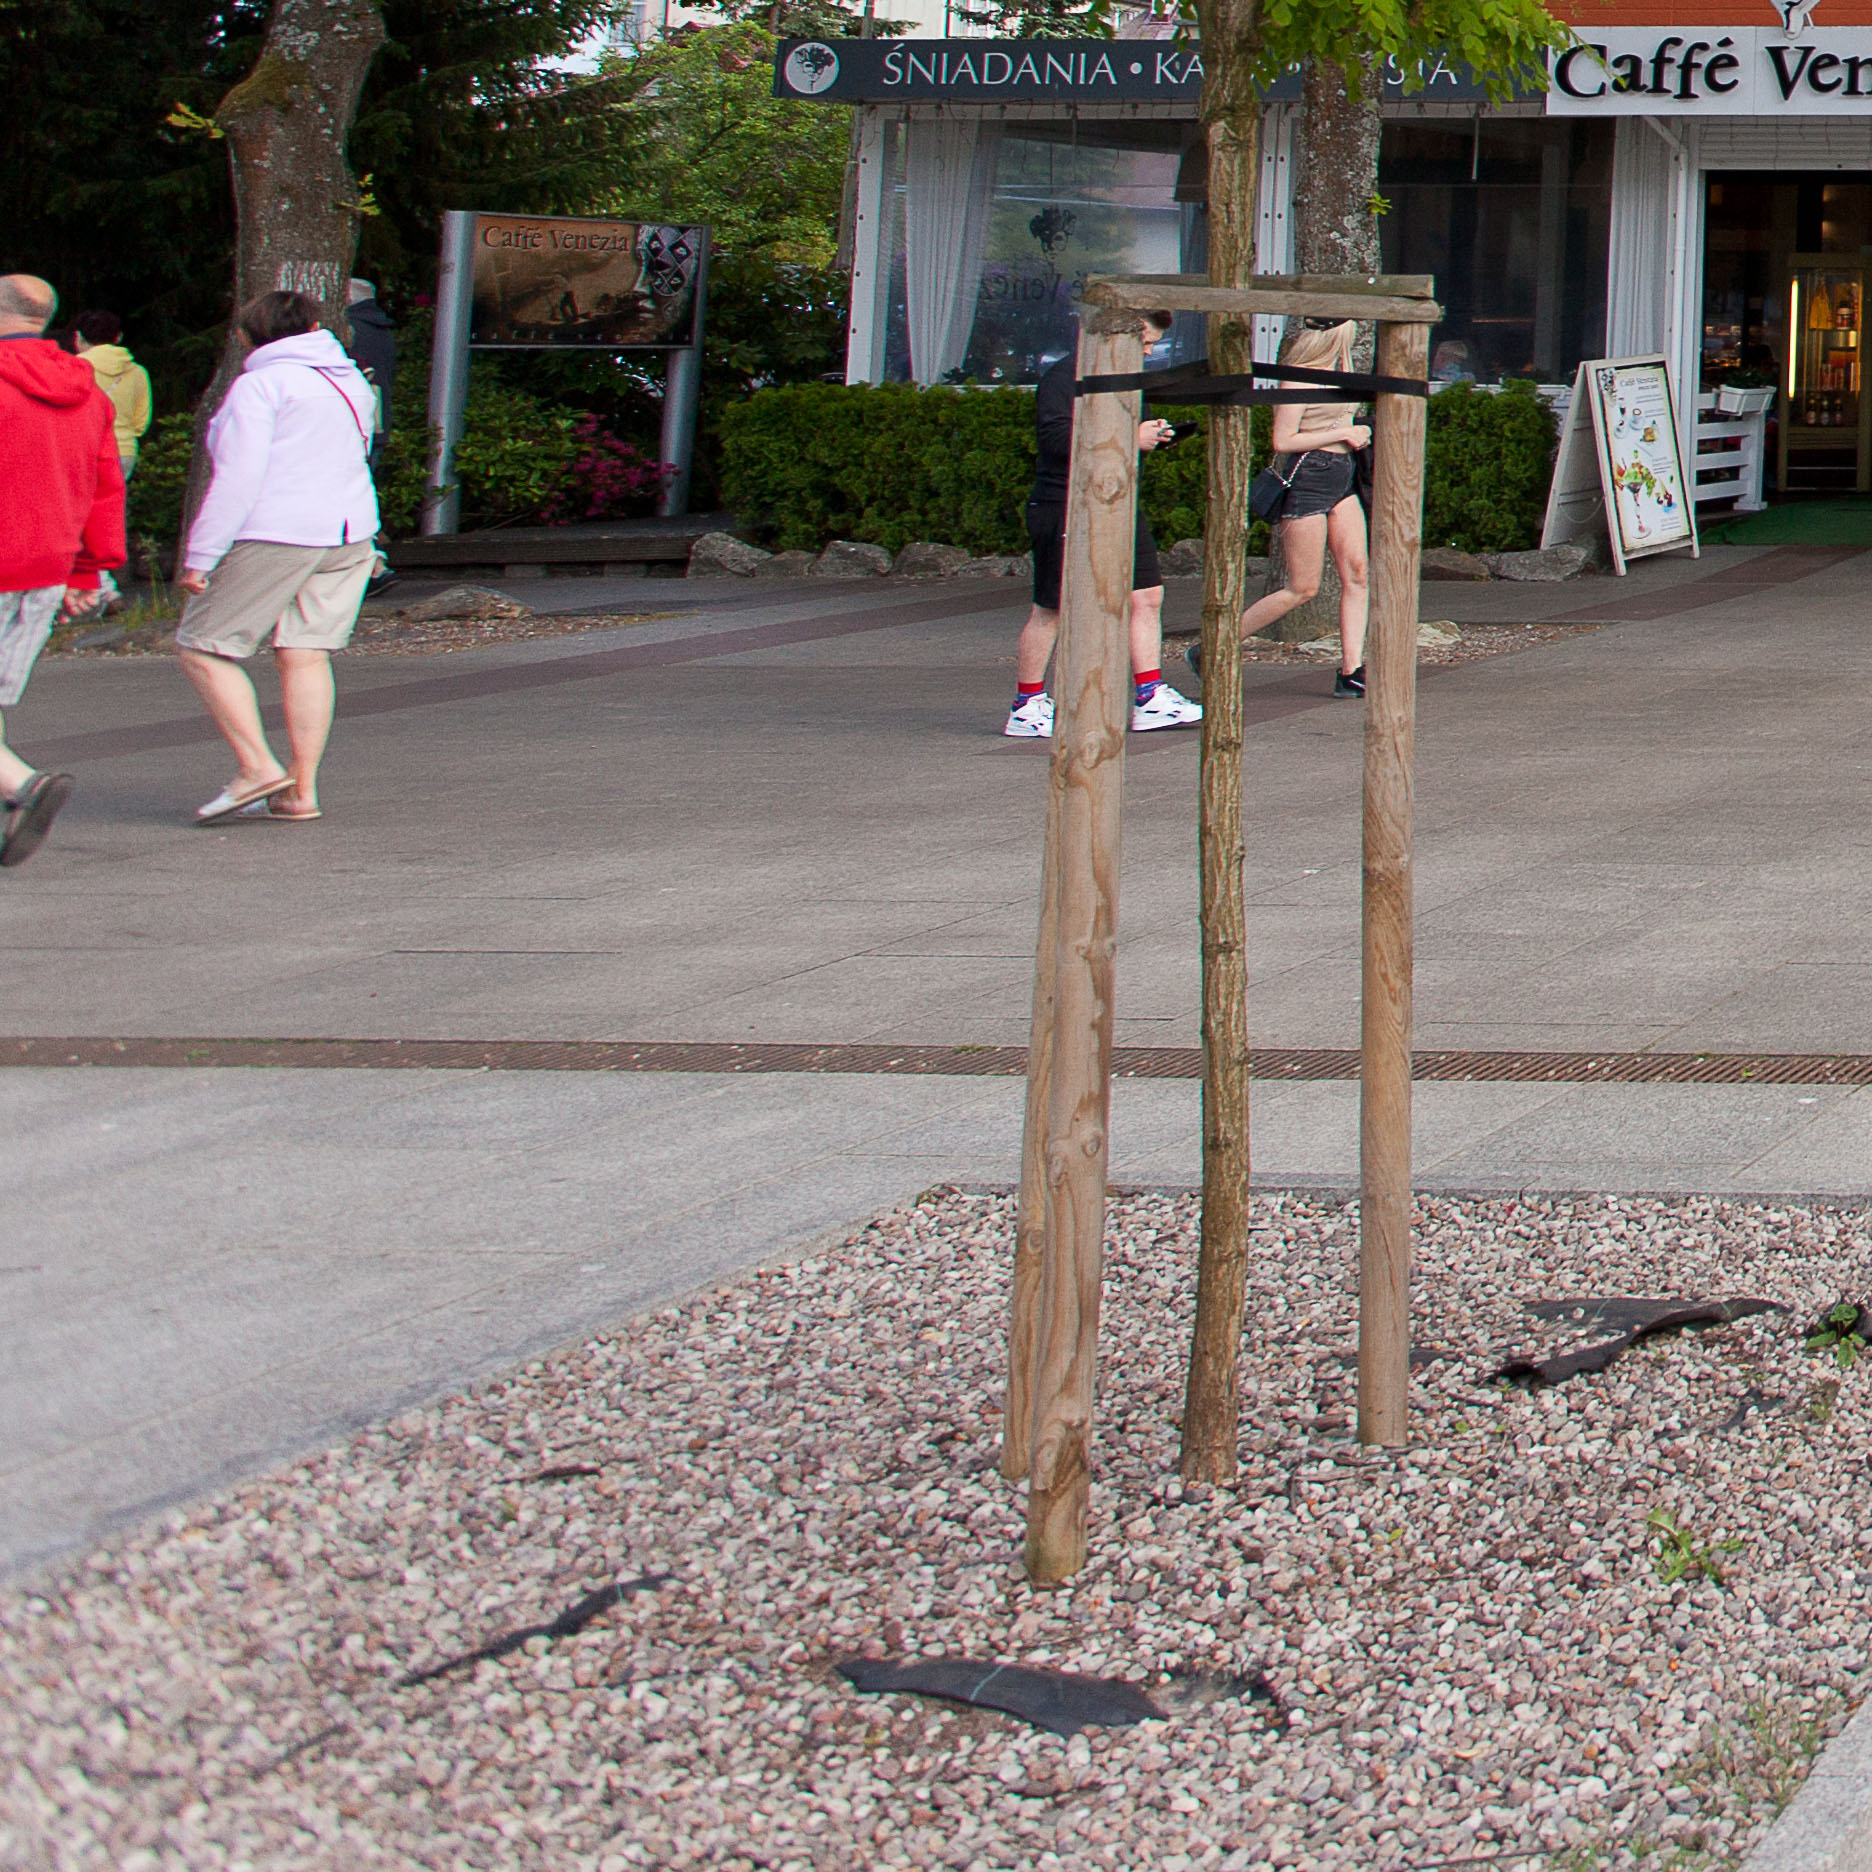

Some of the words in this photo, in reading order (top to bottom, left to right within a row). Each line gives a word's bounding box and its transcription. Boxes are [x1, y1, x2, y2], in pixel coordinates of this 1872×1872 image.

[882, 42, 1118, 85] ŚNIADANIA
[1554, 36, 1740, 100] Caffé
[550, 229, 630, 252] Venezia
